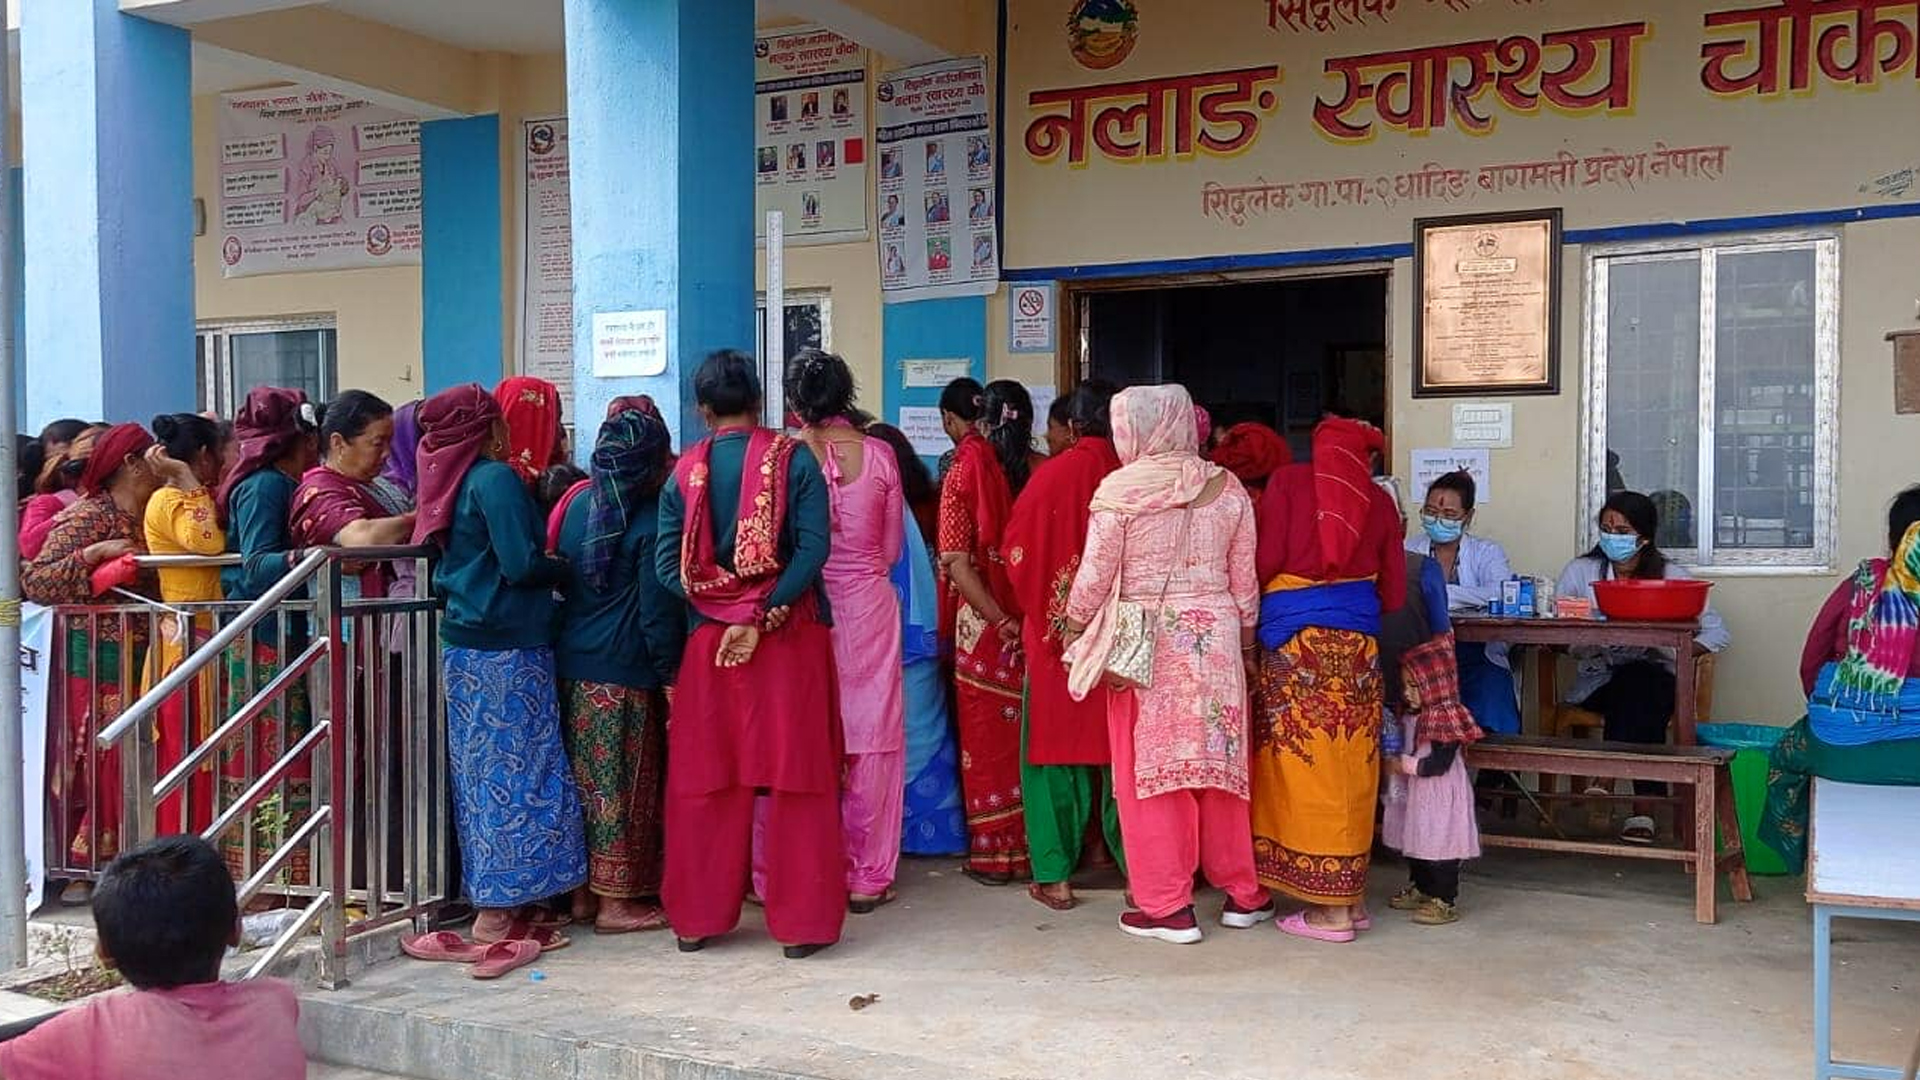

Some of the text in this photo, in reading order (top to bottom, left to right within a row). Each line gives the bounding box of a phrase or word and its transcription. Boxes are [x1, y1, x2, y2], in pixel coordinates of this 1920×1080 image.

[1025, 0, 1920, 165] नलाङ स्वास्थ्य चौक
[1478, 151, 1578, 193] बागमती
[1650, 142, 1731, 181] नेपाल
